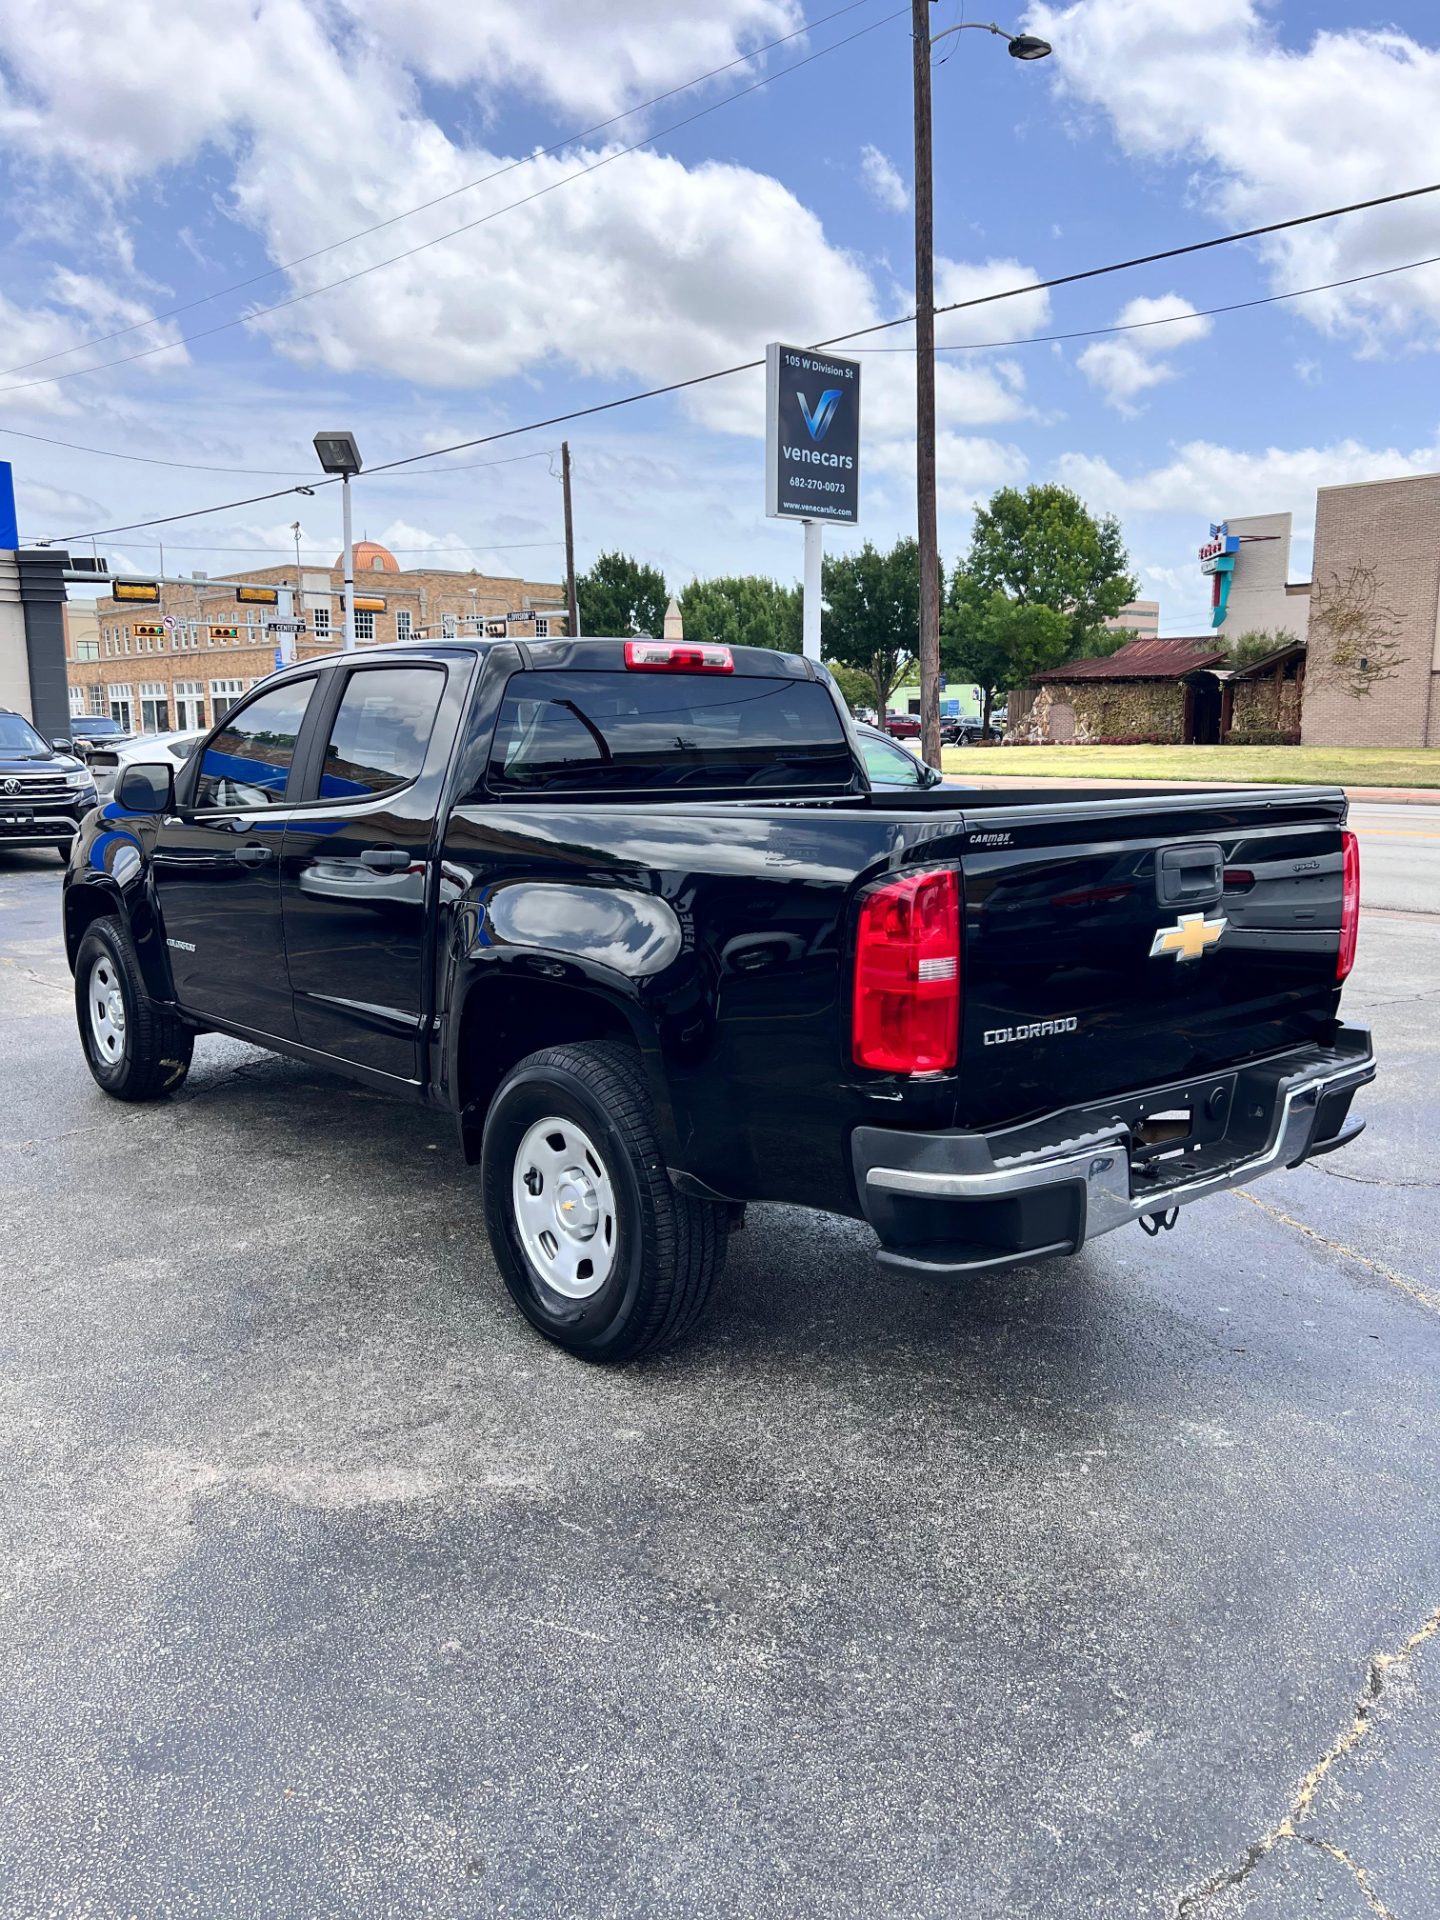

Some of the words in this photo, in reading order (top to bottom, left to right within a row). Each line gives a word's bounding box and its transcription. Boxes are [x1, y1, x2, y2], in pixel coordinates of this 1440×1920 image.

[785, 354, 800, 367] 105
[802, 358, 811, 369] W
[812, 361, 844, 377] Division
[844, 368, 854, 379] St
[782, 445, 853, 470] venecars
[789, 476, 846, 494] 682-270-0073
[782, 501, 852, 516] www.venecarsllc.com
[276, 624, 298, 632] CENTER
[983, 1016, 1078, 1046] COLORADO
